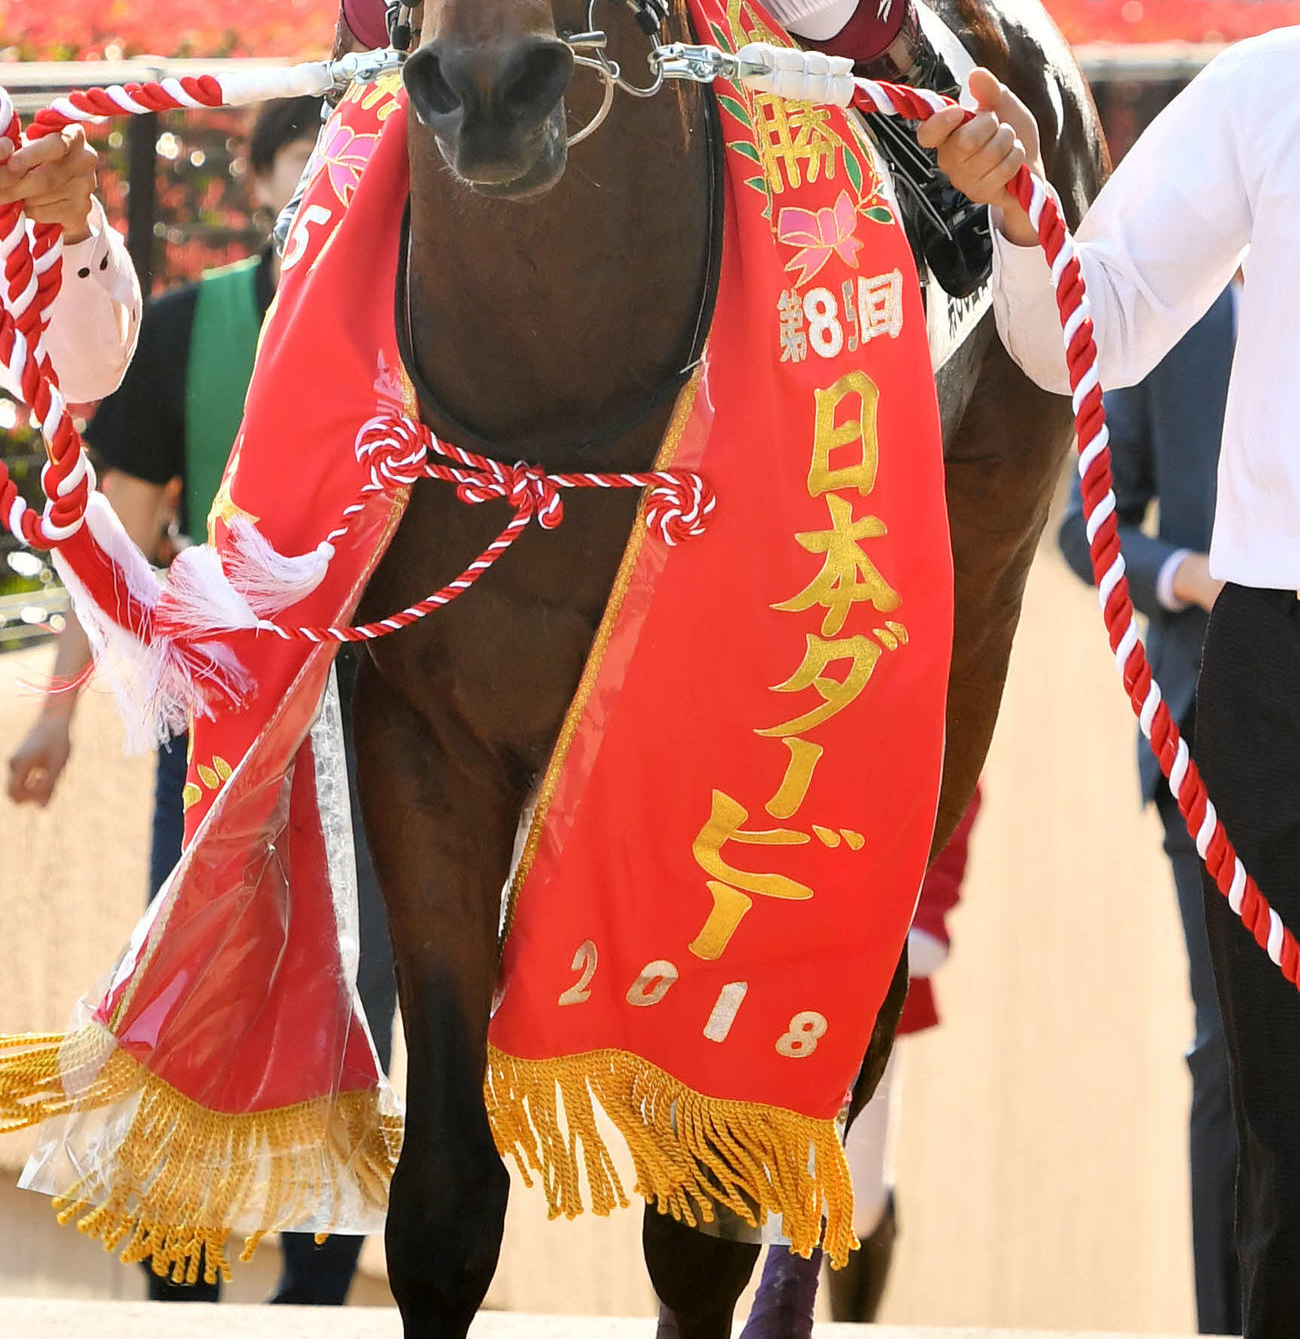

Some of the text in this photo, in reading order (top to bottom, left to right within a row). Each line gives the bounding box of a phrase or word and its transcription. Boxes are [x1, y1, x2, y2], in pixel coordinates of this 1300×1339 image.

[688, 370, 909, 960] 日本ダービー
[558, 941, 827, 1058] 2018
